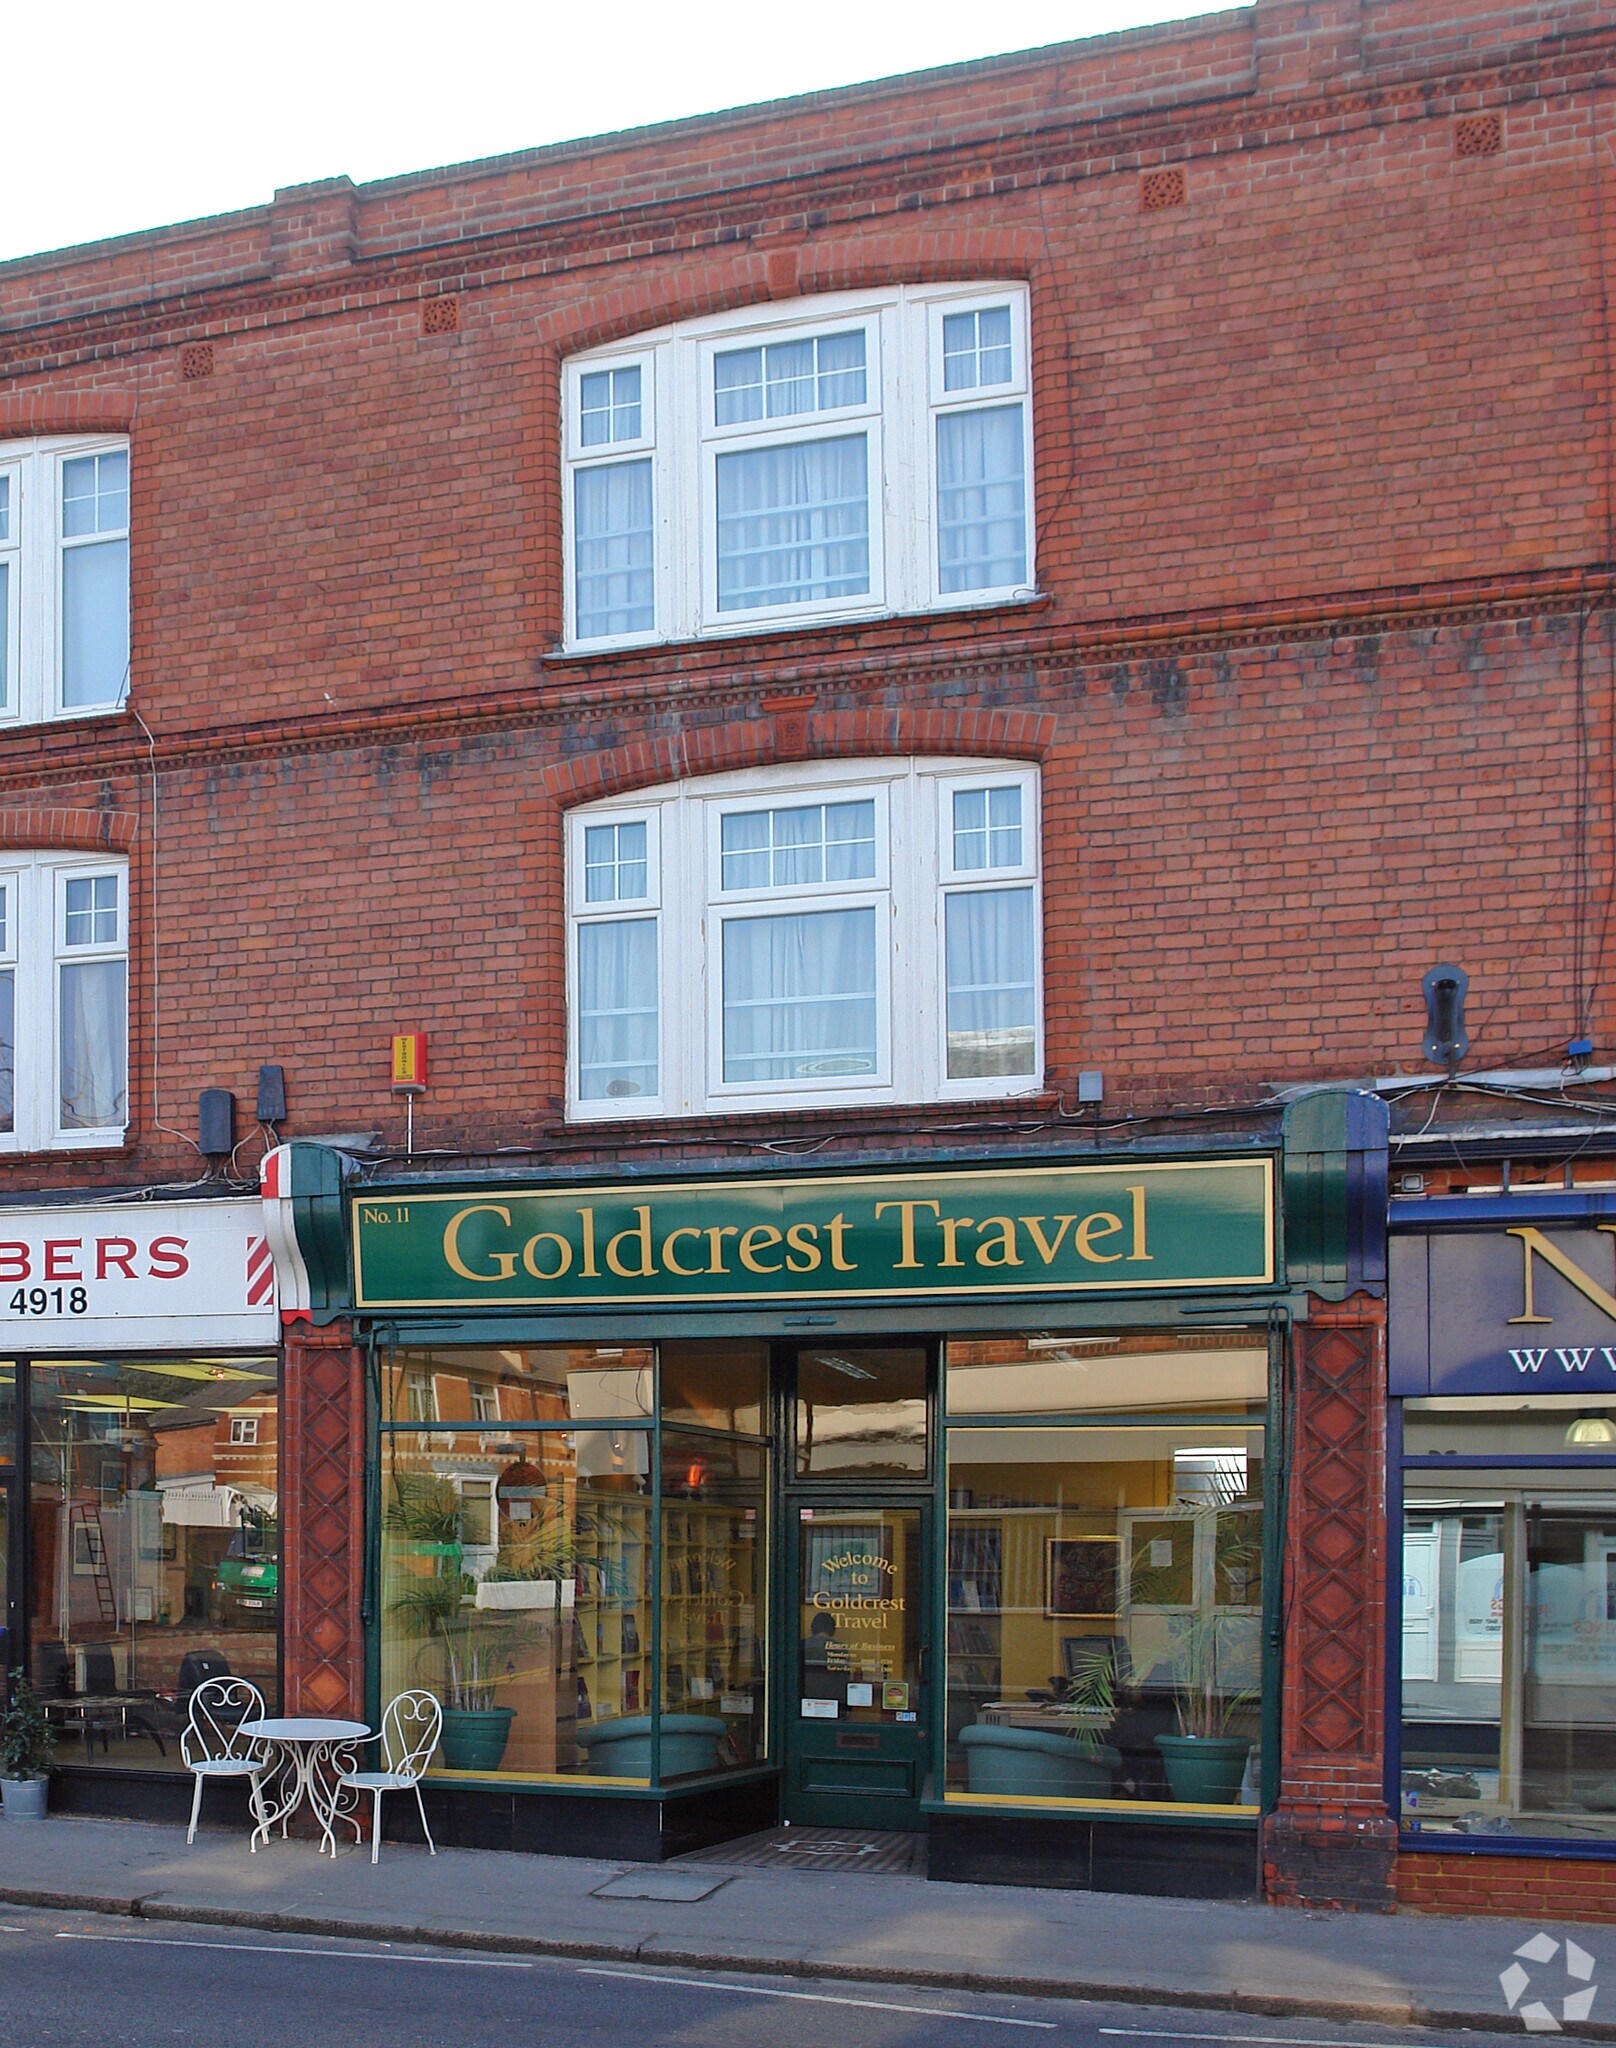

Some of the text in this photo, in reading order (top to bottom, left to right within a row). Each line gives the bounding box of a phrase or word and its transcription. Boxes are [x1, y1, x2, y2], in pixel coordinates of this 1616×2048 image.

[363, 1206, 410, 1224] No. 11
[442, 1186, 1154, 1282] Goldcrest Travel
[0, 1236, 190, 1282] BERS
[9, 1286, 89, 1315] 4918
[821, 1551, 898, 1575] Welcome
[851, 1572, 868, 1585] to
[812, 1591, 906, 1611] Goldcrest
[831, 1612, 888, 1630] Travel
